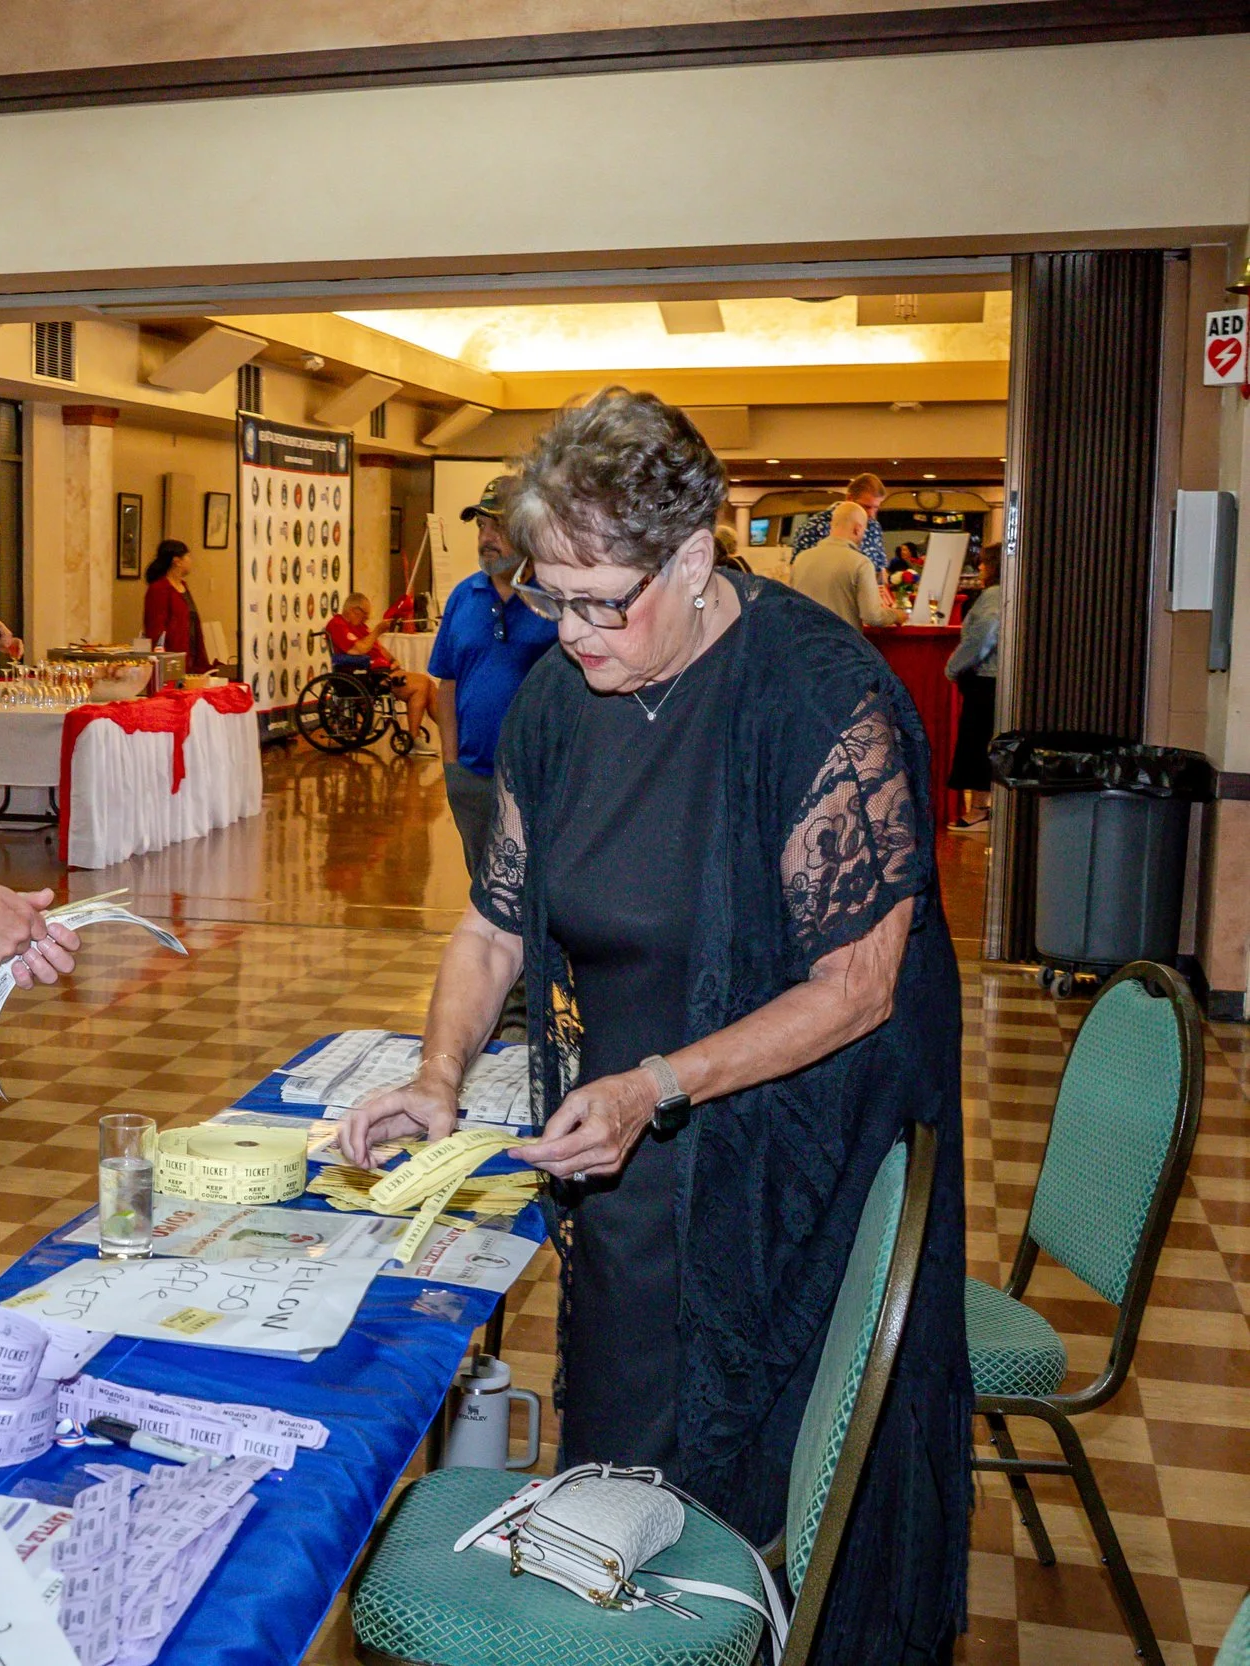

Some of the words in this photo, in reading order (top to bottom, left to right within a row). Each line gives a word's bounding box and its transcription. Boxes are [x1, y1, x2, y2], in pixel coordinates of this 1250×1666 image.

[1209, 315, 1243, 337] AED
[427, 1143, 456, 1163] TICKET
[165, 1159, 187, 1172] TICKET
[202, 1165, 228, 1177] TICKET
[245, 1168, 270, 1178] TICKET
[283, 1161, 300, 1173] TICKET
[385, 1169, 414, 1193] TICKET
[201, 1192, 228, 1200] COUPON
[405, 1219, 427, 1249] TICKET
[42, 1266, 125, 1320] CKETS
[260, 1258, 338, 1330] YELLOW
[0, 1346, 30, 1362] TICKET
[98, 1387, 131, 1402] COUPON
[222, 1409, 258, 1421] COUPON
[459, 1413, 488, 1422] STANLEY
[138, 1417, 170, 1435] TICKET
[278, 1419, 314, 1431] COUPON
[190, 1428, 222, 1446] TICKET
[281, 1432, 305, 1440] KEEP
[243, 1439, 280, 1458] TICKET
